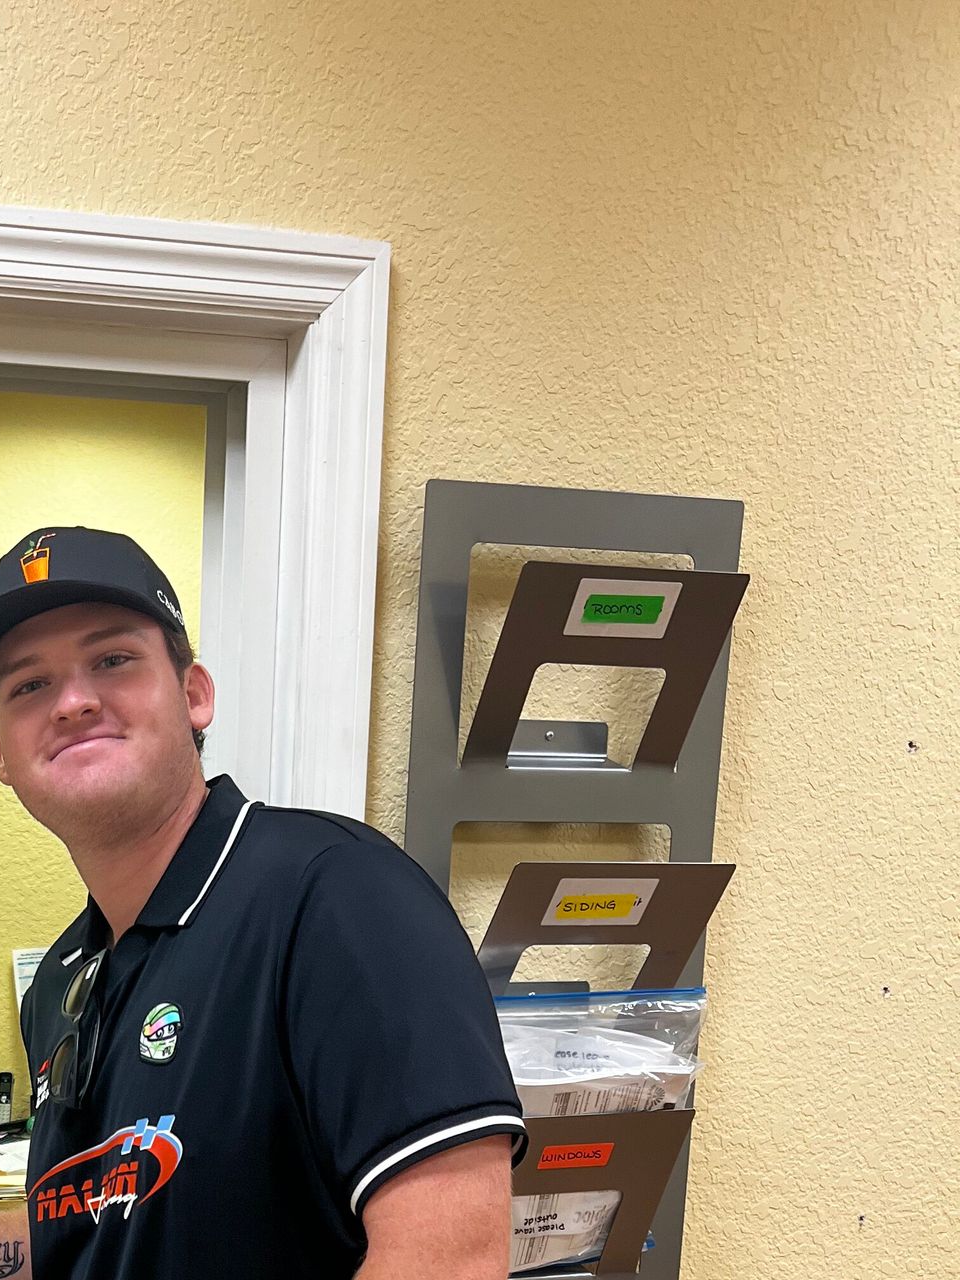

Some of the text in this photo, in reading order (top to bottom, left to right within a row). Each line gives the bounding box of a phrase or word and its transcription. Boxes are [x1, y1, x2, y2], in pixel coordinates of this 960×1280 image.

[563, 900, 616, 912] SIDING
[541, 1150, 602, 1163] WINDOWS
[523, 1212, 558, 1226] outside
[514, 1223, 566, 1235] Please leave
